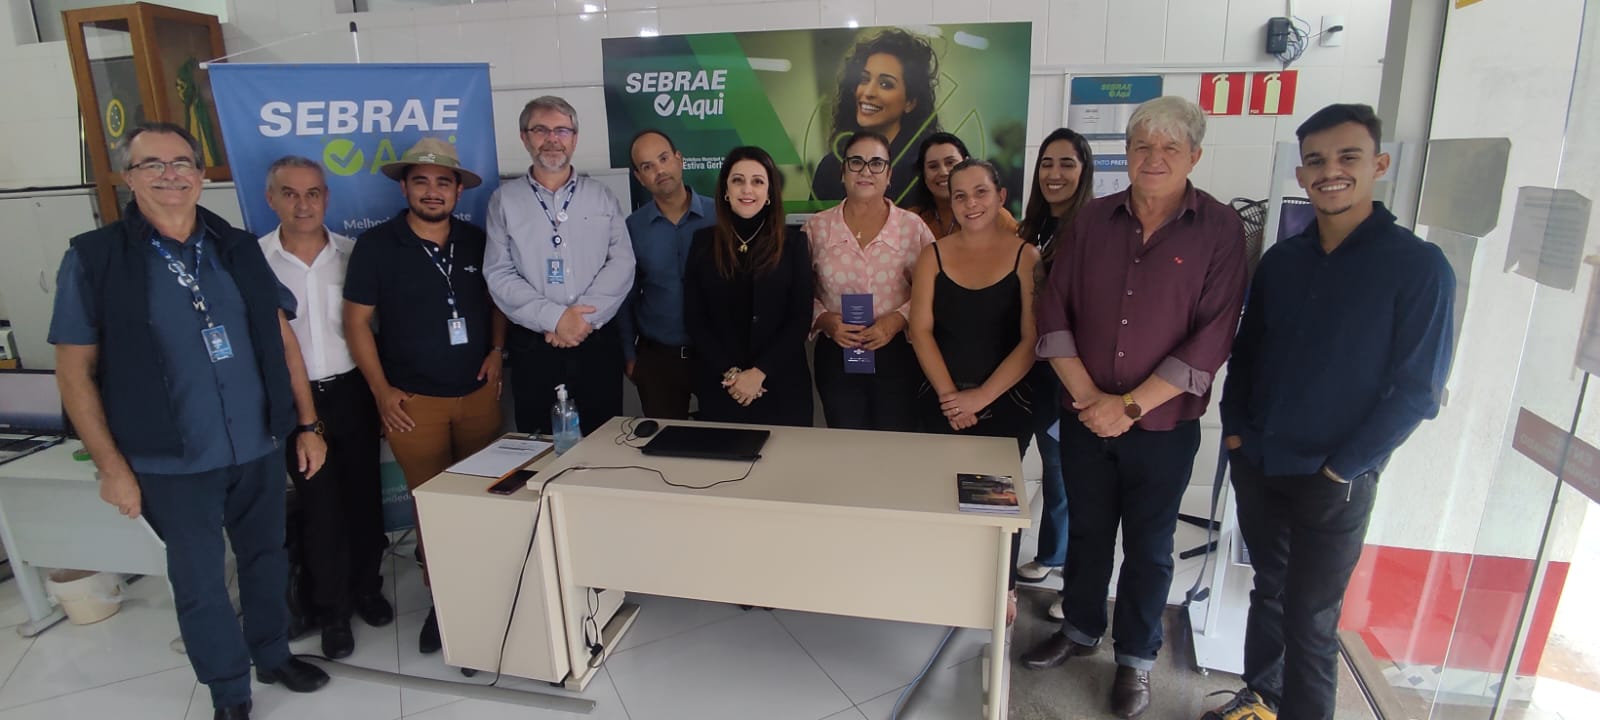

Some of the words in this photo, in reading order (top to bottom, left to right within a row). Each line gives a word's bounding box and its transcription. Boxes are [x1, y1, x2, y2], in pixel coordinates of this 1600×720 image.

[626, 69, 727, 93] SEBRAE
[259, 98, 459, 137] SEBRAE
[676, 92, 724, 119] Aqui
[683, 161, 705, 170] Estiva
